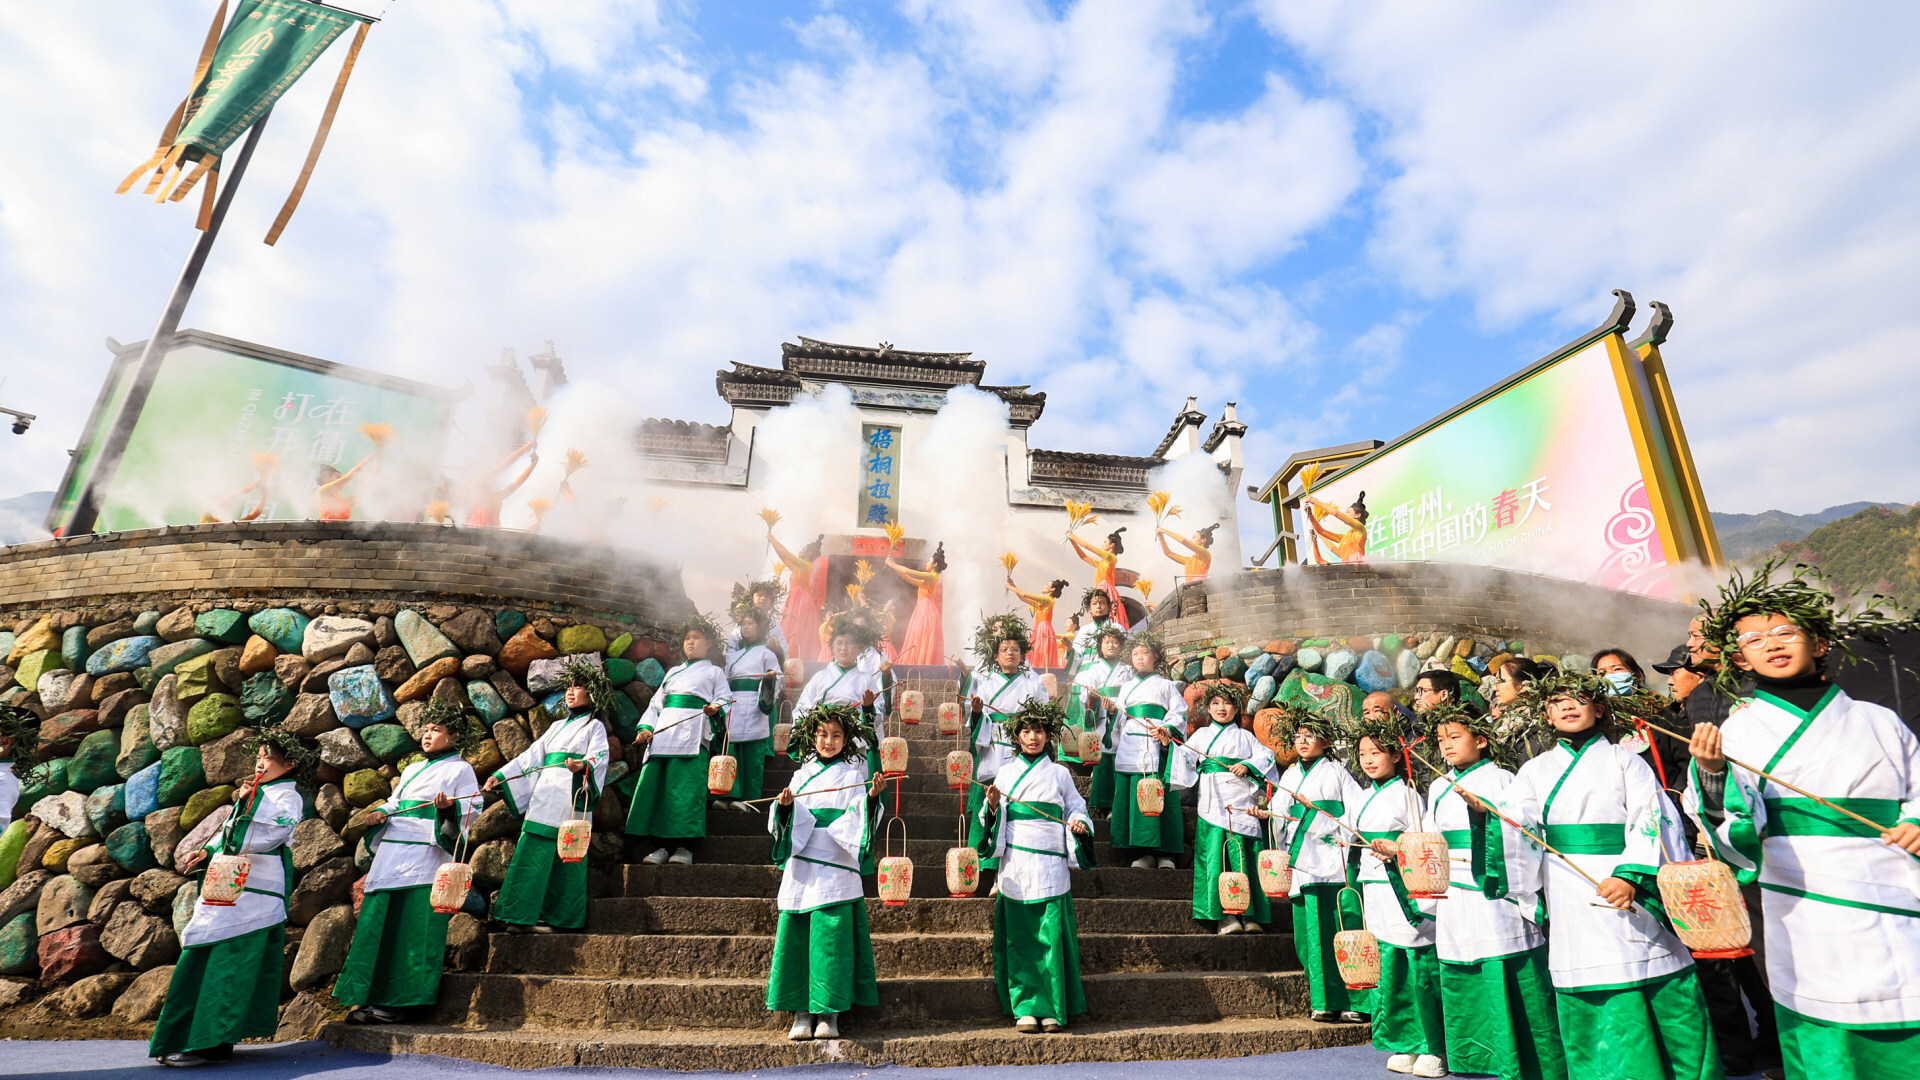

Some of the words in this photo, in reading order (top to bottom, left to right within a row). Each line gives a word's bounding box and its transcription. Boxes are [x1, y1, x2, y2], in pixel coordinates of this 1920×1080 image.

[866, 428, 894, 525] 梧桐祖殿
[1506, 534, 1520, 548] OF
[1419, 849, 1442, 876] 春
[437, 874, 452, 891] 春
[899, 867, 911, 887] 春
[1681, 884, 1722, 922] 春
[1361, 944, 1378, 968] 春
